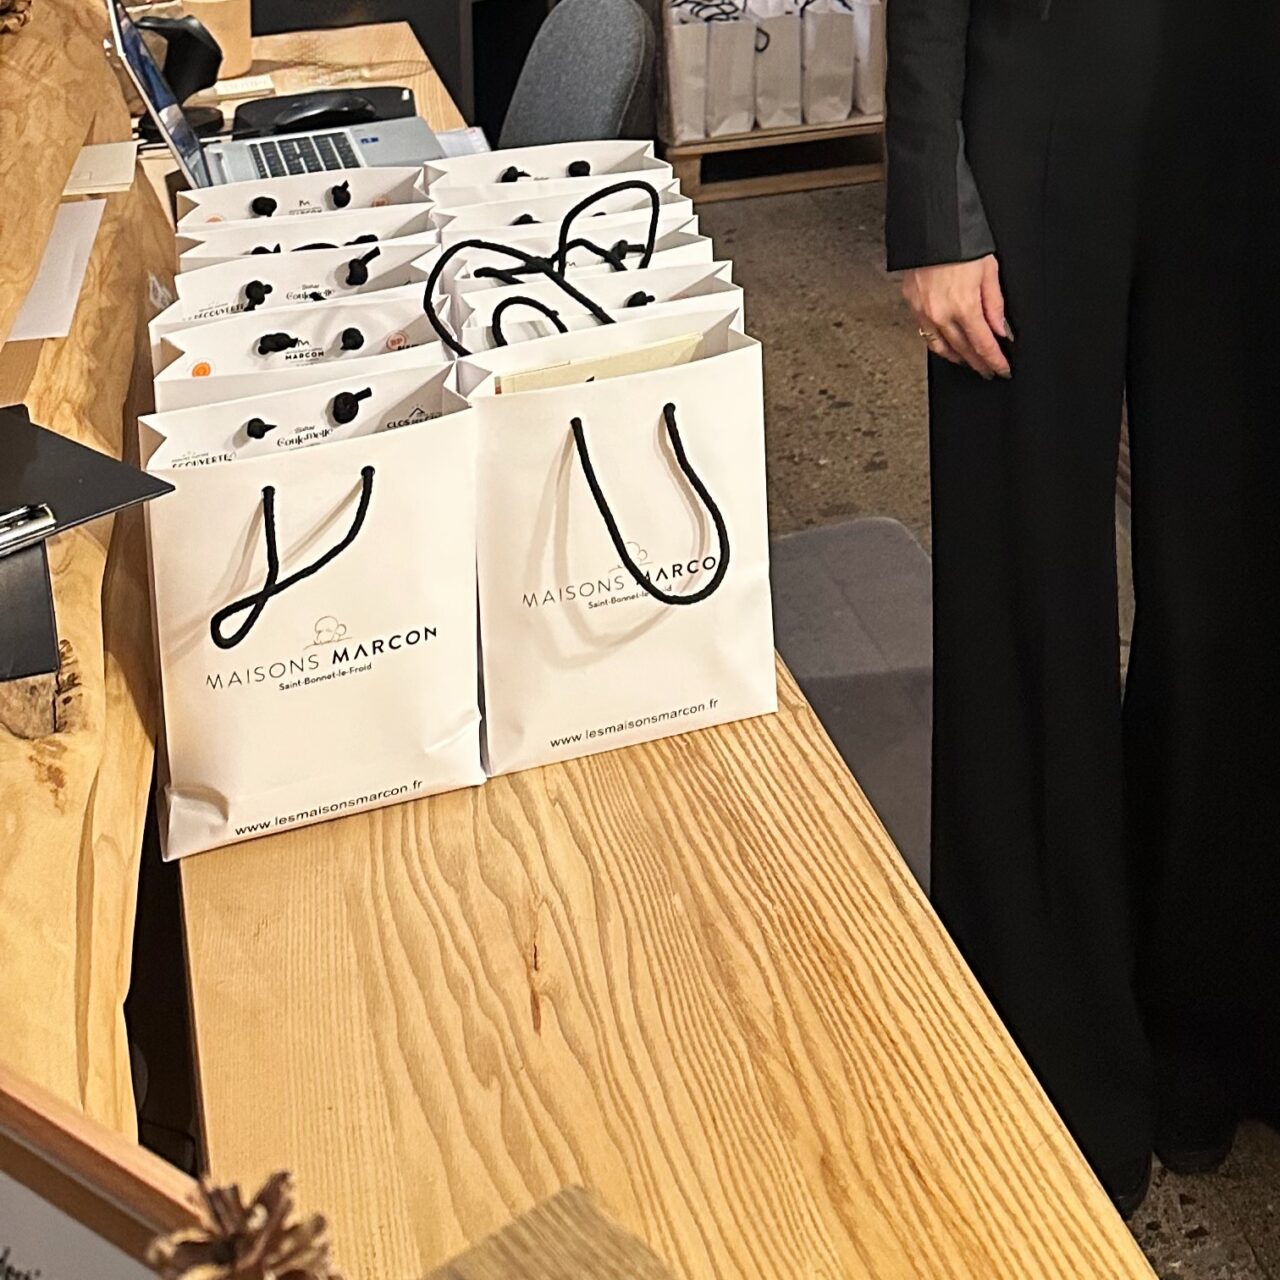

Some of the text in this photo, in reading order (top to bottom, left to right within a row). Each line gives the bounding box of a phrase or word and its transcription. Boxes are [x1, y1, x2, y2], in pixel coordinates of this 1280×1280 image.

[285, 351, 324, 361] MARCON
[522, 556, 718, 609] MAISONS ARCO
[205, 626, 437, 691] MAISONS MARCON
